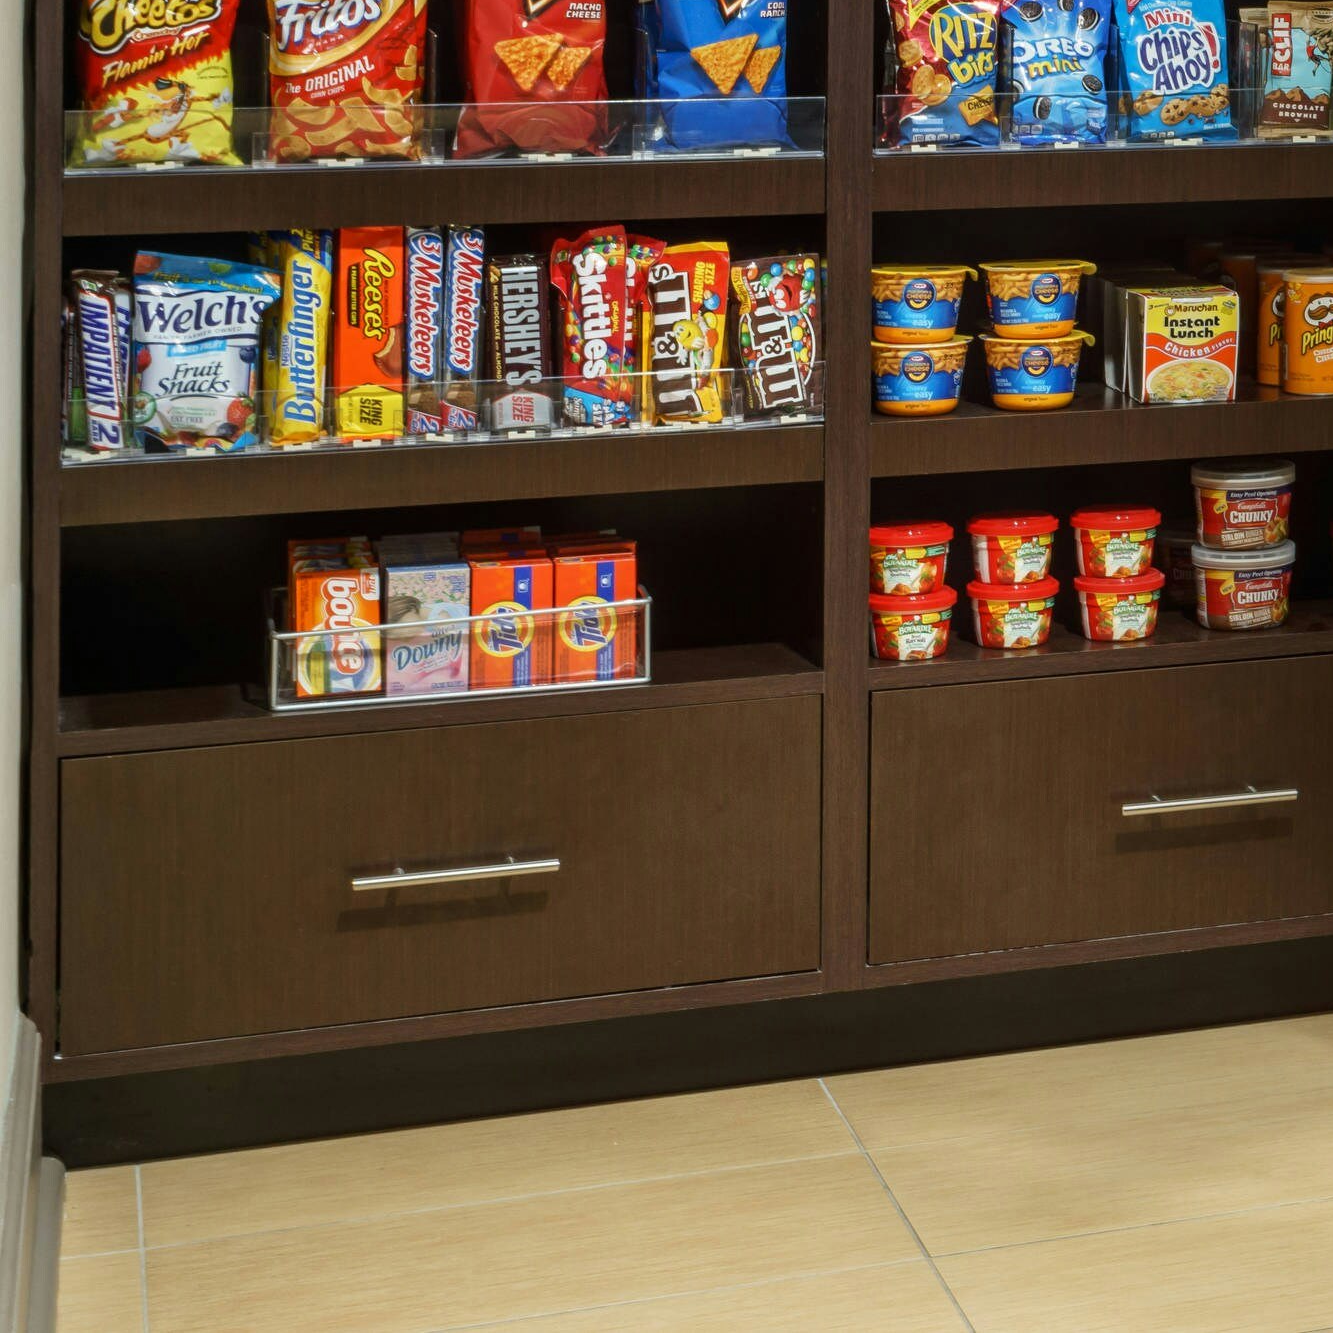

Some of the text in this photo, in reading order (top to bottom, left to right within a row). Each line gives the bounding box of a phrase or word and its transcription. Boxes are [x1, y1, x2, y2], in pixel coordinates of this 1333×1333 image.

[566, 10, 601, 19] CHEESE
[569, 2, 601, 11] NACHO
[760, 9, 785, 18] RANCH
[1144, 10, 1193, 30] Mini
[934, 13, 993, 58] RITZ
[1140, 27, 1203, 70] Chips
[1274, 17, 1291, 62] CLIF
[1013, 37, 1094, 63] OREO
[285, 55, 375, 94] The ORIGINAL
[950, 51, 994, 84] bits
[1027, 58, 1083, 77] mini
[1272, 62, 1290, 71] BAR
[1272, 102, 1324, 112] CHOCOLATE
[1278, 111, 1317, 119] BROWNIE
[692, 261, 705, 303] SHARING
[705, 262, 715, 285] SIZE
[363, 248, 395, 340] Reese's
[409, 236, 442, 376] 3 Musketeers
[451, 232, 483, 372] 3 Musketeers
[1174, 303, 1218, 313] Maruchan
[137, 295, 266, 334] Welch's
[501, 265, 542, 387] HERSHEY'S
[573, 252, 611, 379] Skittles
[1163, 316, 1220, 328] Instant
[283, 259, 322, 425] Butterfinger
[1169, 327, 1213, 339] Lunch
[81, 299, 115, 412] IMPATIENT
[1164, 341, 1212, 358] Chicken
[172, 361, 224, 380] Fruit
[155, 377, 230, 398] Snacks
[359, 397, 369, 425] SIZE
[371, 398, 382, 427] KING
[511, 394, 522, 422] SIZE
[523, 395, 534, 423] KING
[1230, 510, 1274, 524] CHUNKY
[1237, 589, 1279, 604] CHUNKY
[392, 631, 463, 670] Downy
